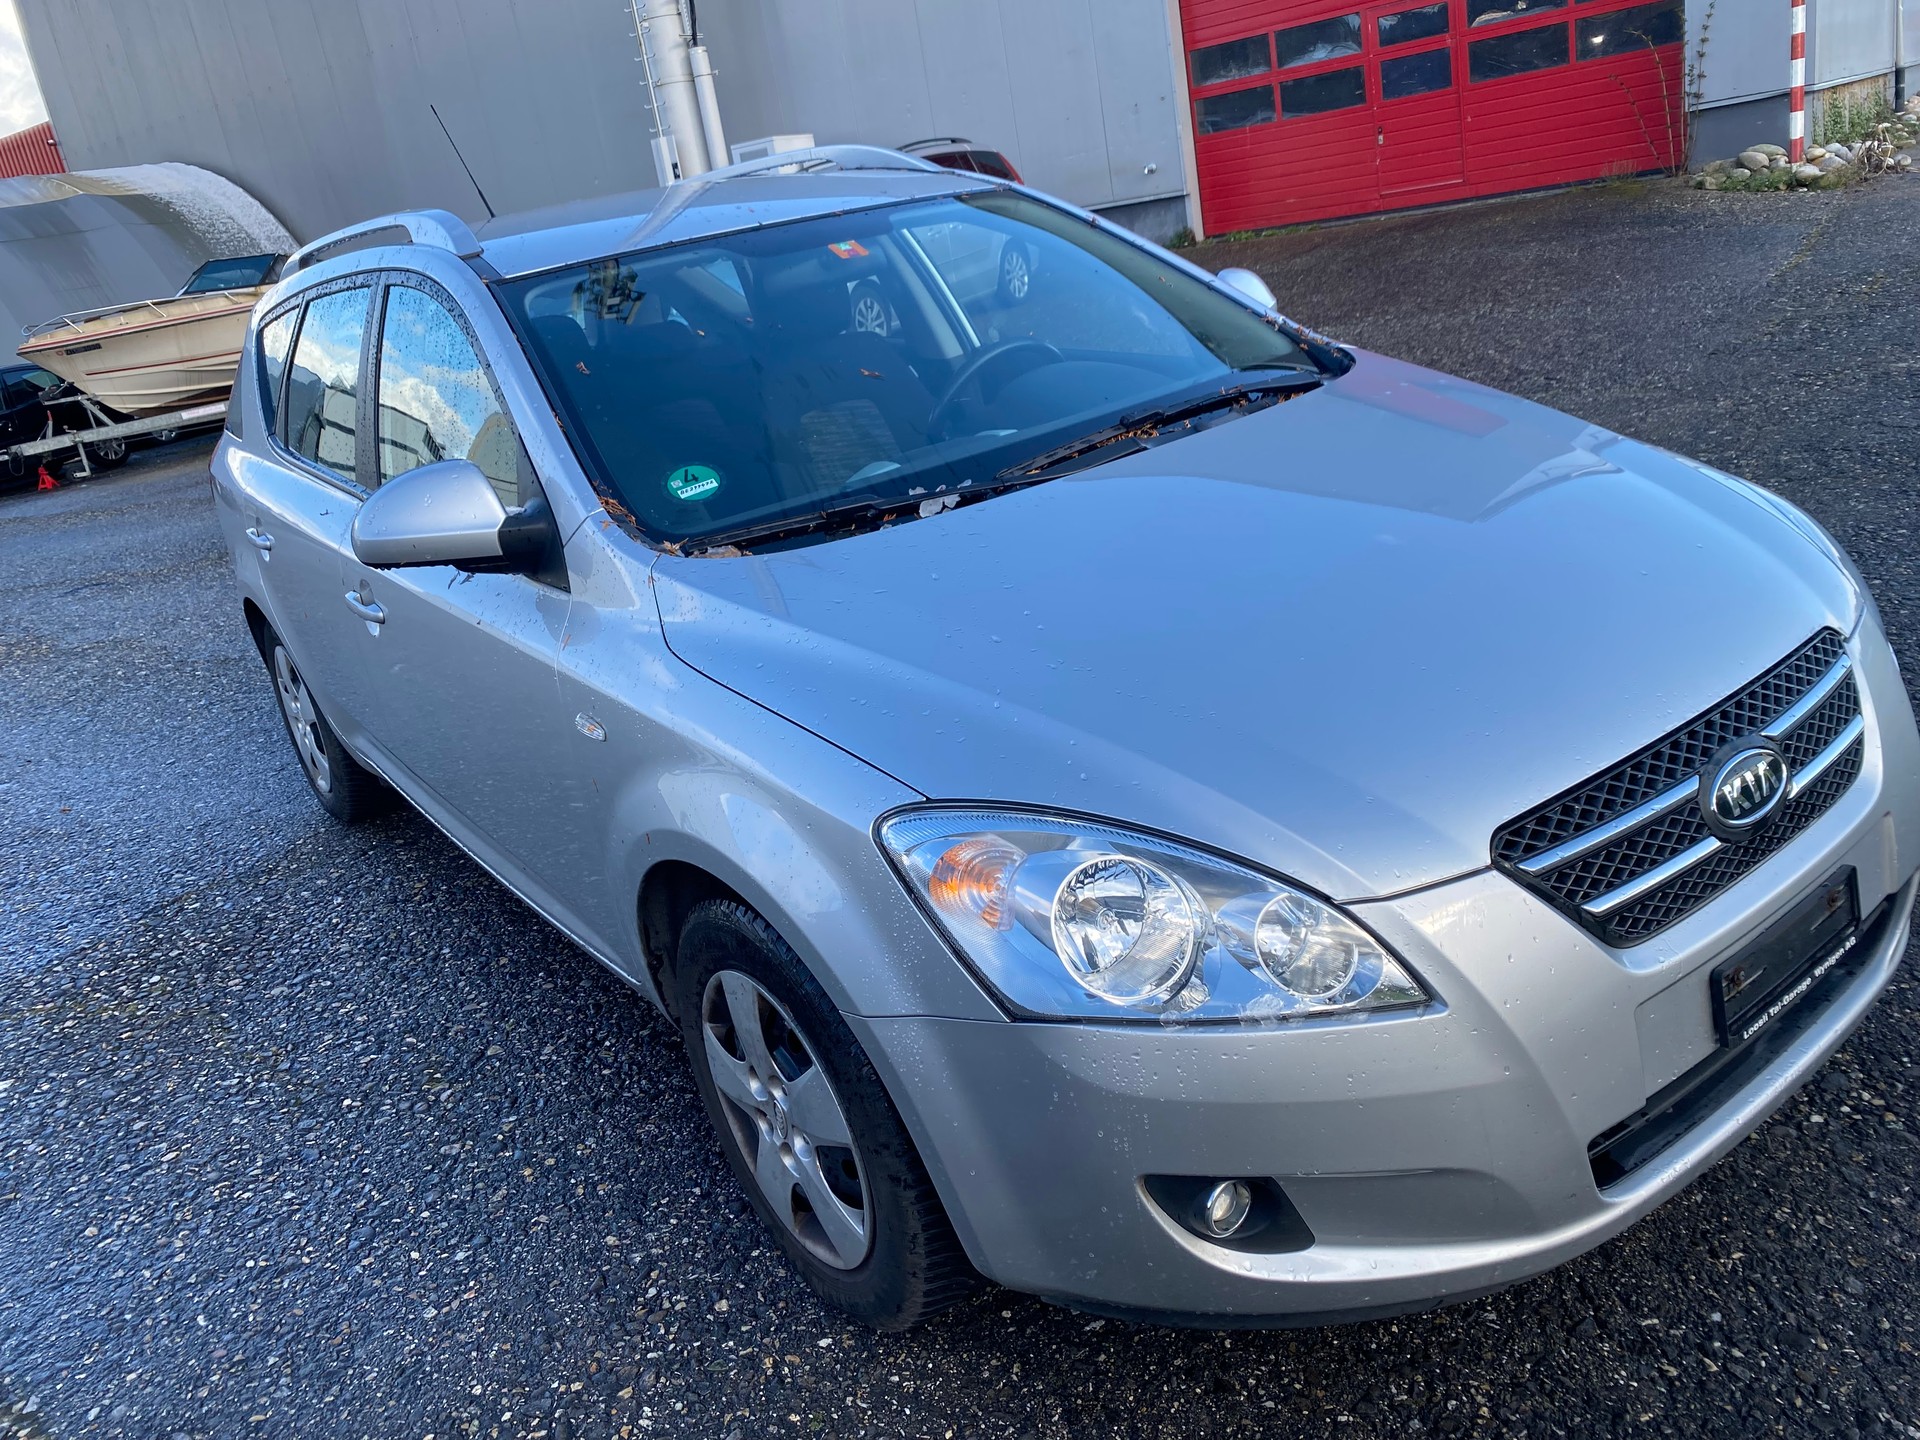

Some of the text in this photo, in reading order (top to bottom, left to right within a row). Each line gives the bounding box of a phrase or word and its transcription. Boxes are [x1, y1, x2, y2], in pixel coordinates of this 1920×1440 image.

[684, 468, 699, 483] 4
[1721, 760, 1780, 817] KIA
[1743, 1013, 1769, 1039] Loosli
[1845, 936, 1857, 951] AG
